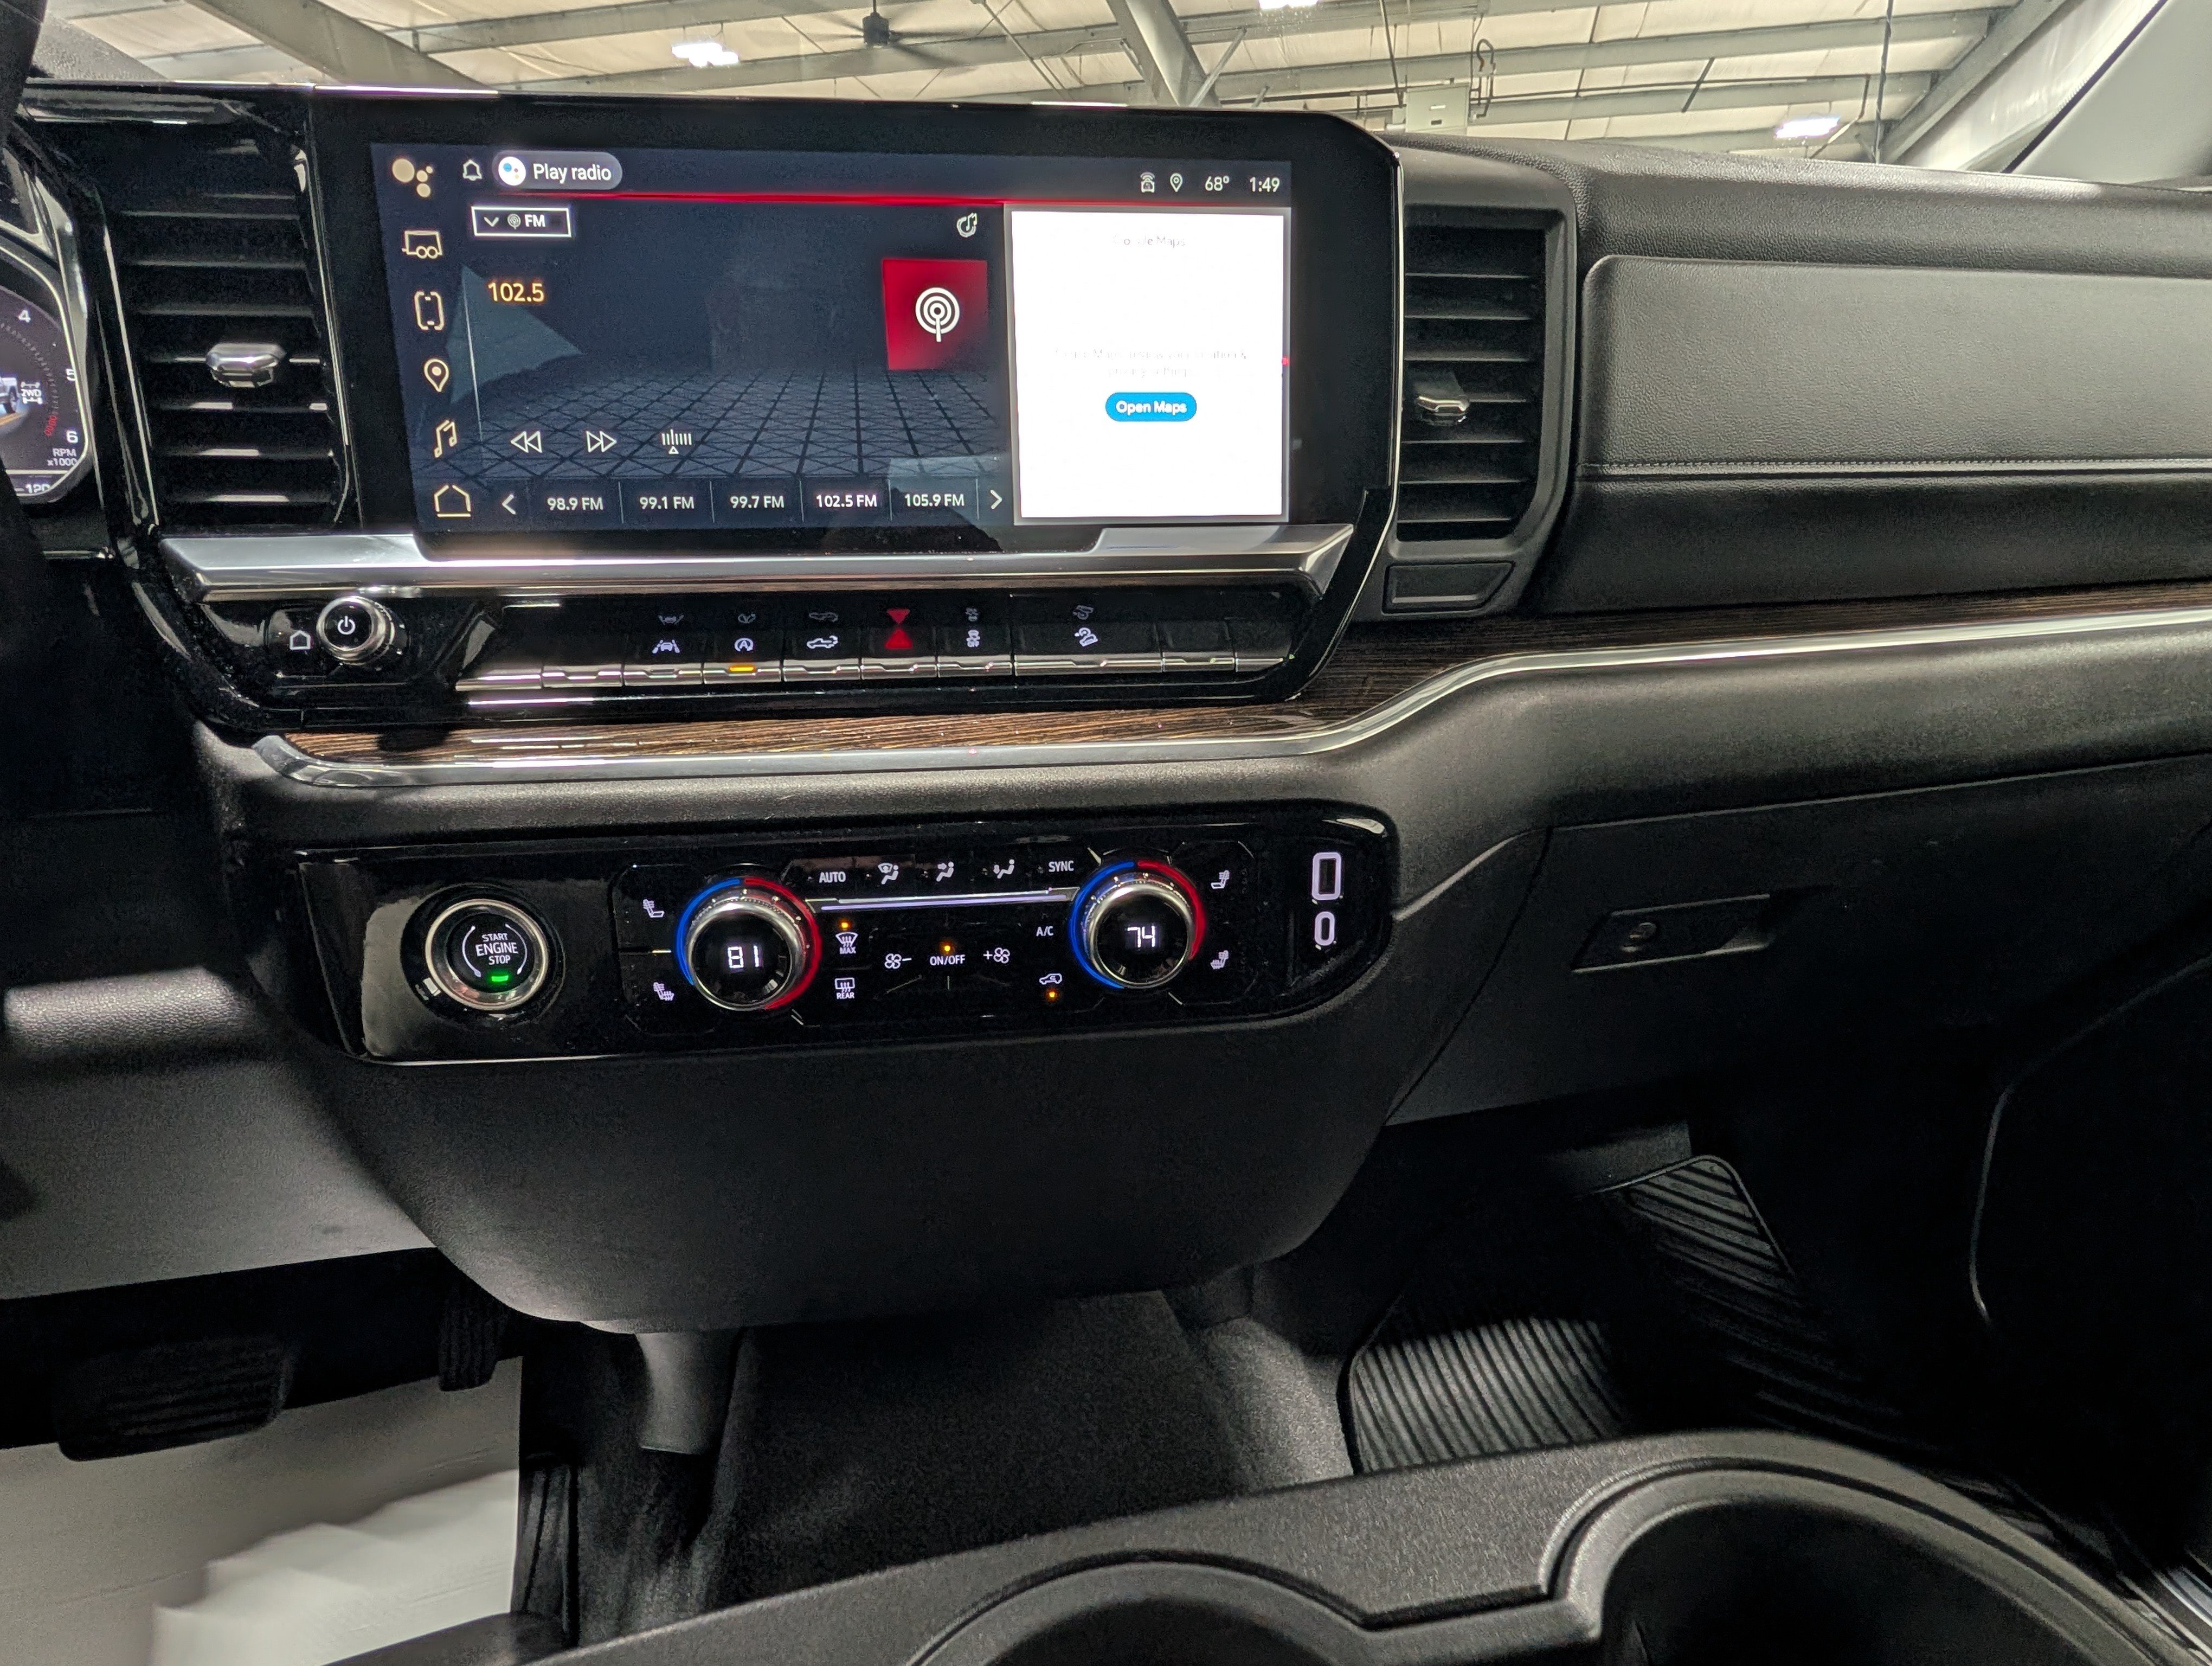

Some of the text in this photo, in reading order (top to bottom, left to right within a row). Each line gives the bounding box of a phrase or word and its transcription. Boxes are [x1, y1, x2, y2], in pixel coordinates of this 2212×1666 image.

[533, 163, 612, 184] Play radio
[1249, 177, 1280, 193] 1:49
[524, 214, 545, 227] FM
[487, 282, 544, 302] 102.5
[18, 310, 31, 323] 4
[66, 369, 75, 381] 5
[1116, 400, 1187, 415] Open Maps
[66, 430, 79, 443] 6
[53, 448, 77, 457] RPM
[547, 497, 603, 510] 98.9 FM
[640, 496, 695, 509] 99.1 FM
[730, 496, 785, 509] 99.7 FM
[816, 494, 877, 508] 102.5 FM
[905, 494, 964, 507] 105.9 FM
[1048, 860, 1075, 873] SYNC
[819, 871, 846, 883] AUTO
[481, 933, 509, 942] START
[1036, 926, 1054, 937] A/C
[1127, 925, 1156, 948] 74
[475, 942, 519, 957] ENGINE
[839, 946, 857, 954] MAX
[488, 956, 511, 965] STOP
[727, 945, 760, 969] 81
[929, 954, 966, 966] ON/OFF
